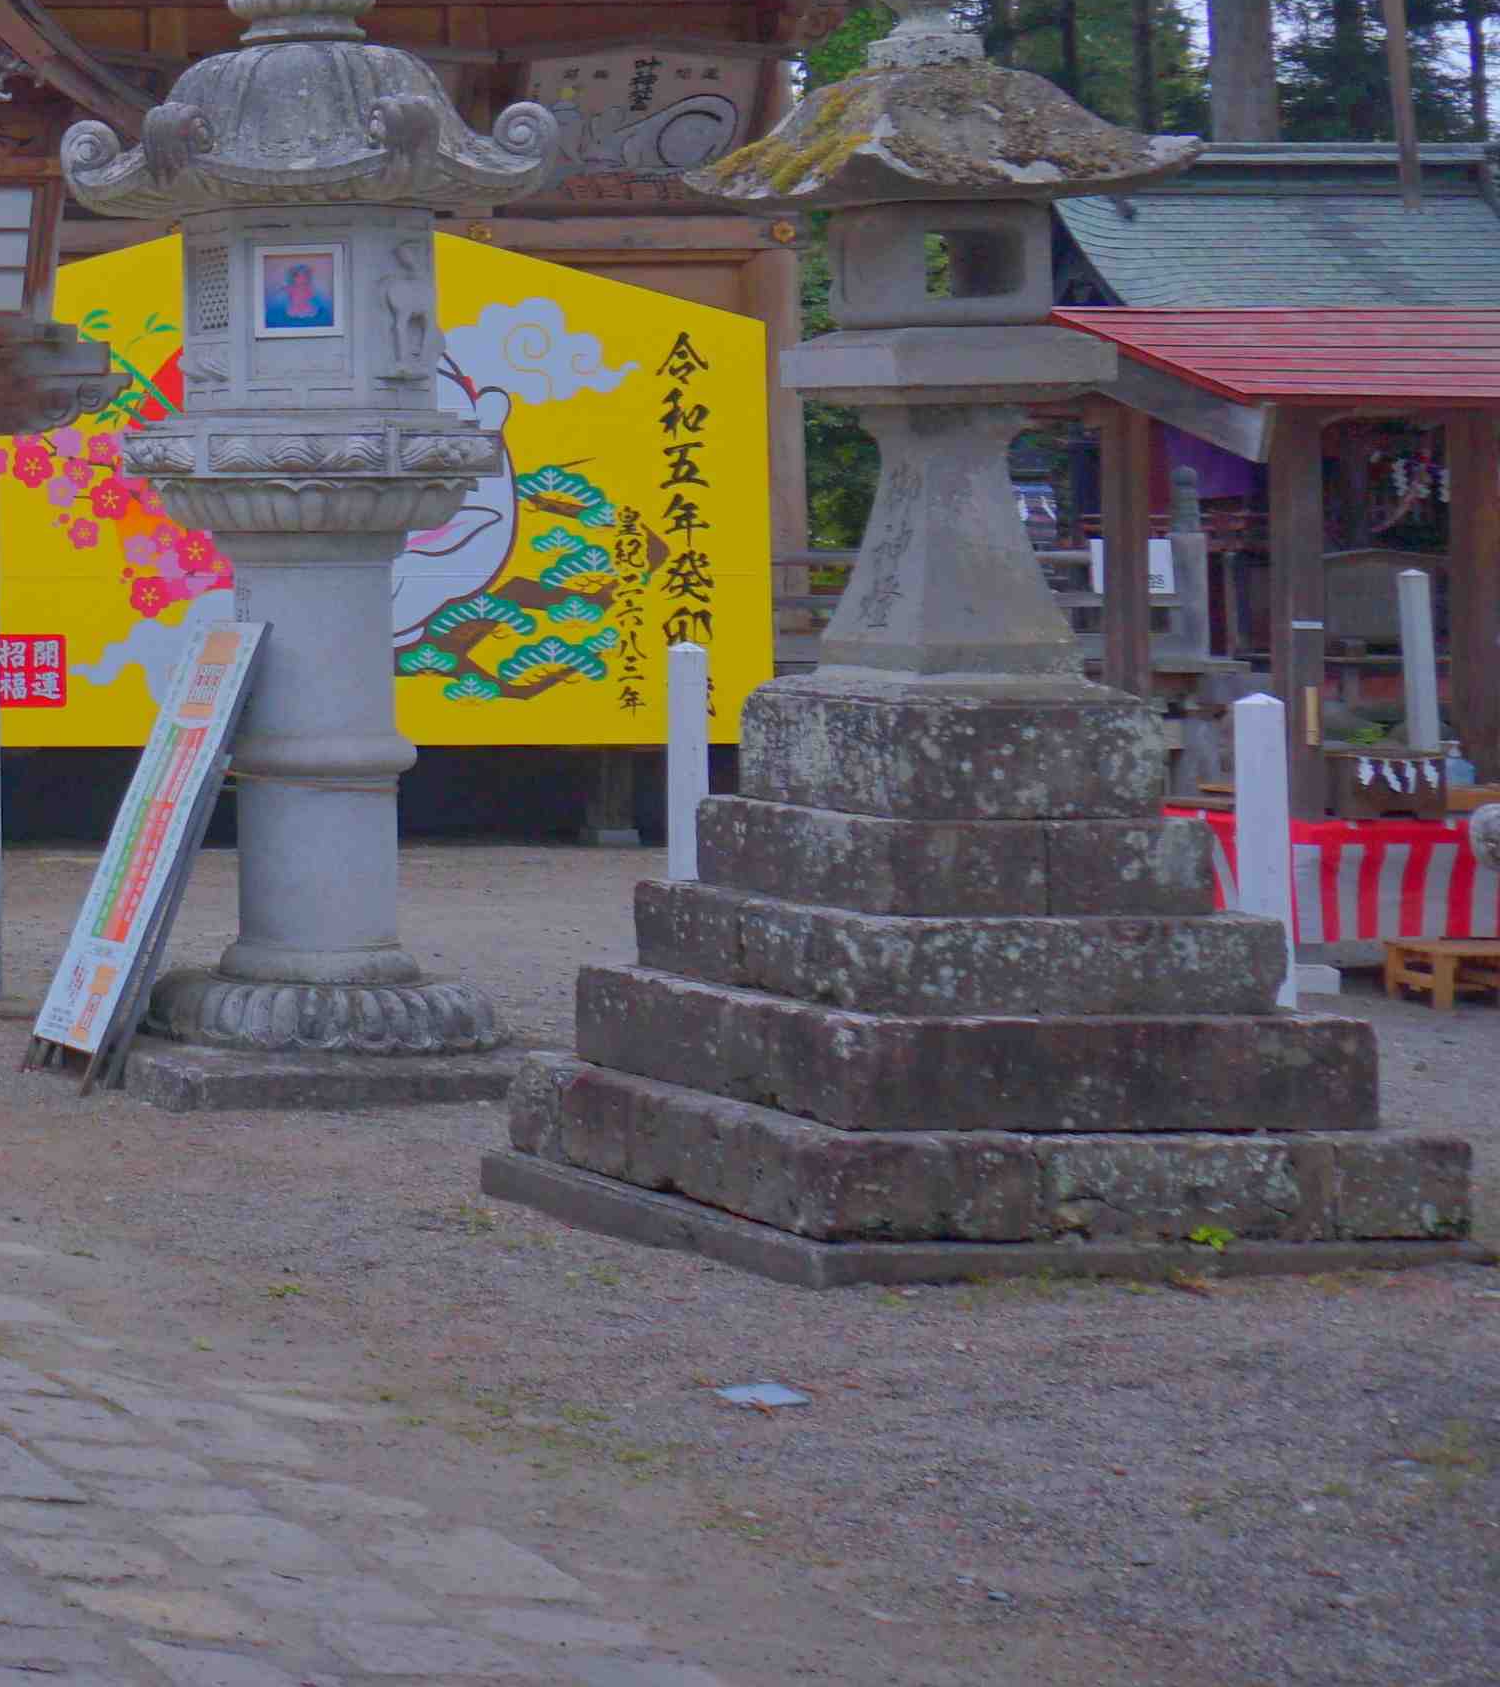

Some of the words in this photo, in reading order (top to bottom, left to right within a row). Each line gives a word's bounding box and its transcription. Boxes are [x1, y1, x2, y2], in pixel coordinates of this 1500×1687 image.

[613, 505, 648, 718] 皇紀二六八三年
[655, 331, 717, 718] 令和五年癸卯
[32, 639, 61, 700] 開運
